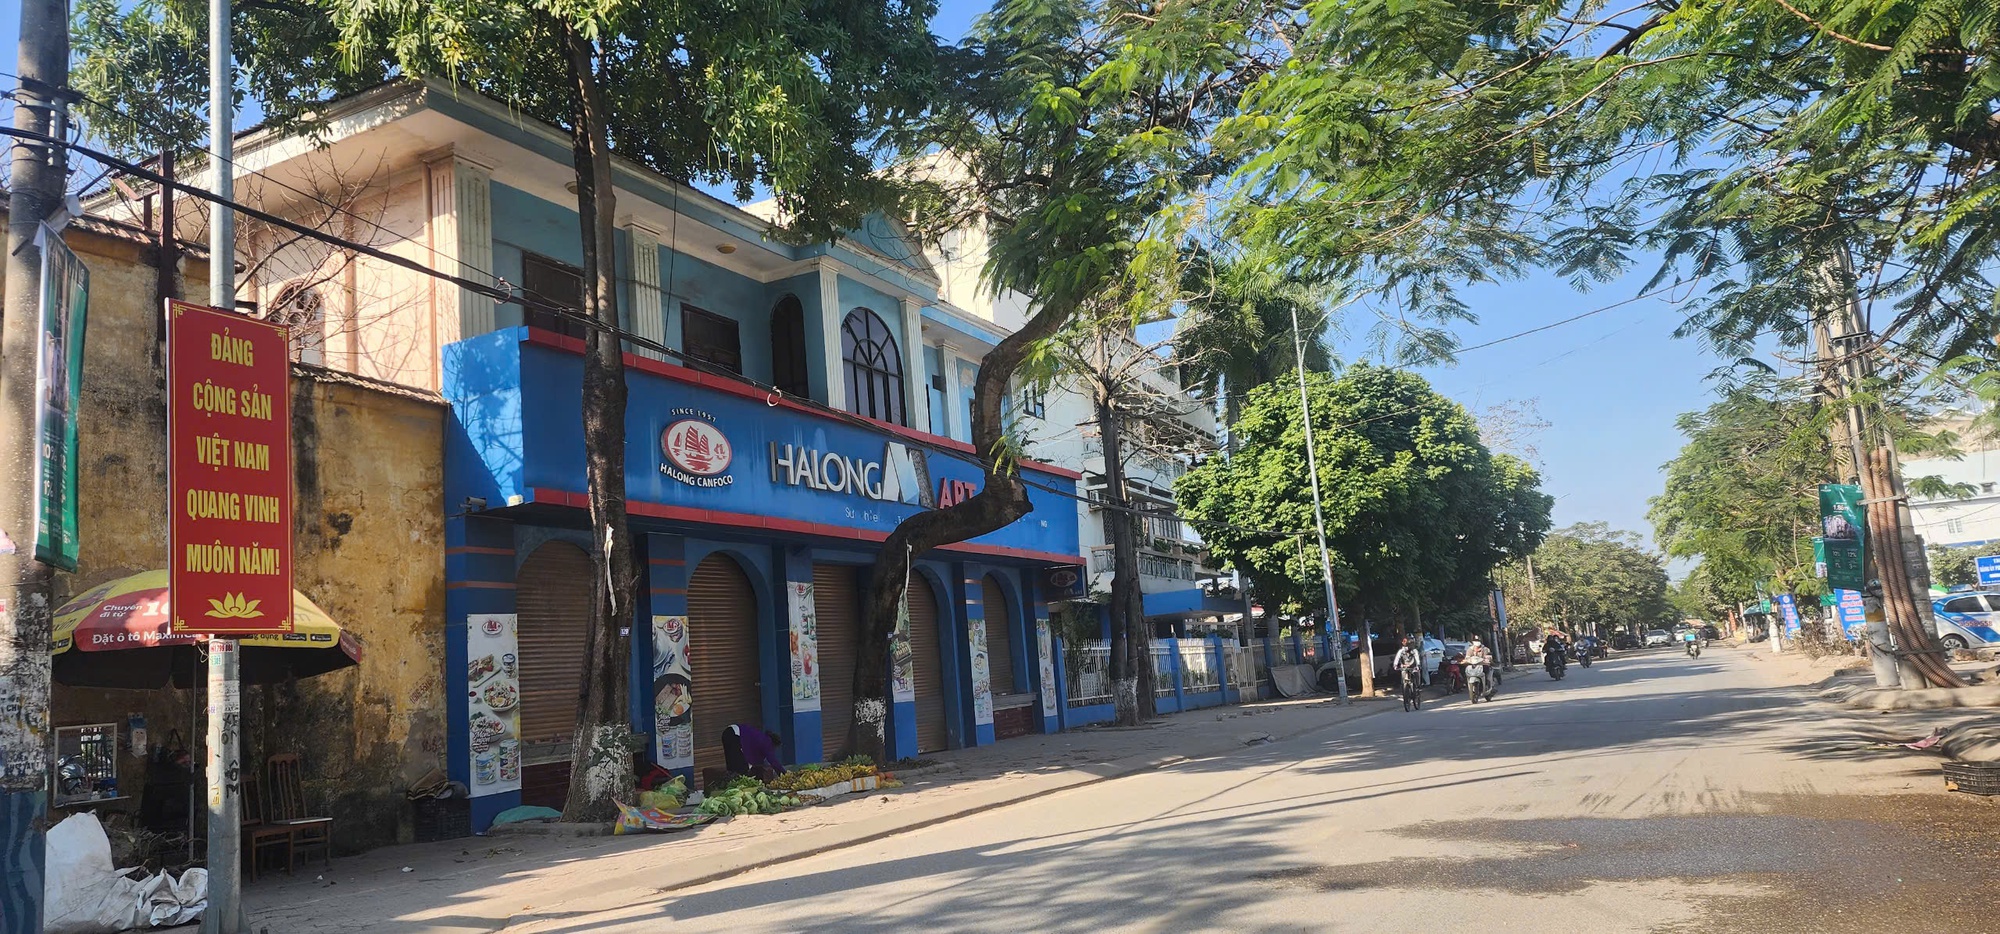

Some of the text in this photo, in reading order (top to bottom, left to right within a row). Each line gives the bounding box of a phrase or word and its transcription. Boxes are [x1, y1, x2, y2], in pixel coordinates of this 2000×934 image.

[211, 327, 253, 366] ĐẢNG
[193, 379, 272, 420] CỘNG SẢN
[698, 410, 716, 422] 1957
[196, 433, 269, 471] VIỆT NAM
[660, 463, 733, 487] HALONG CANFOCO
[769, 441, 882, 500] HALONG
[187, 489, 279, 523] QUANG VINH
[187, 540, 279, 575] MUÔN NĂM!
[93, 634, 114, 645] Đặt
[117, 633, 125, 642] ô
[128, 631, 140, 642] tô
